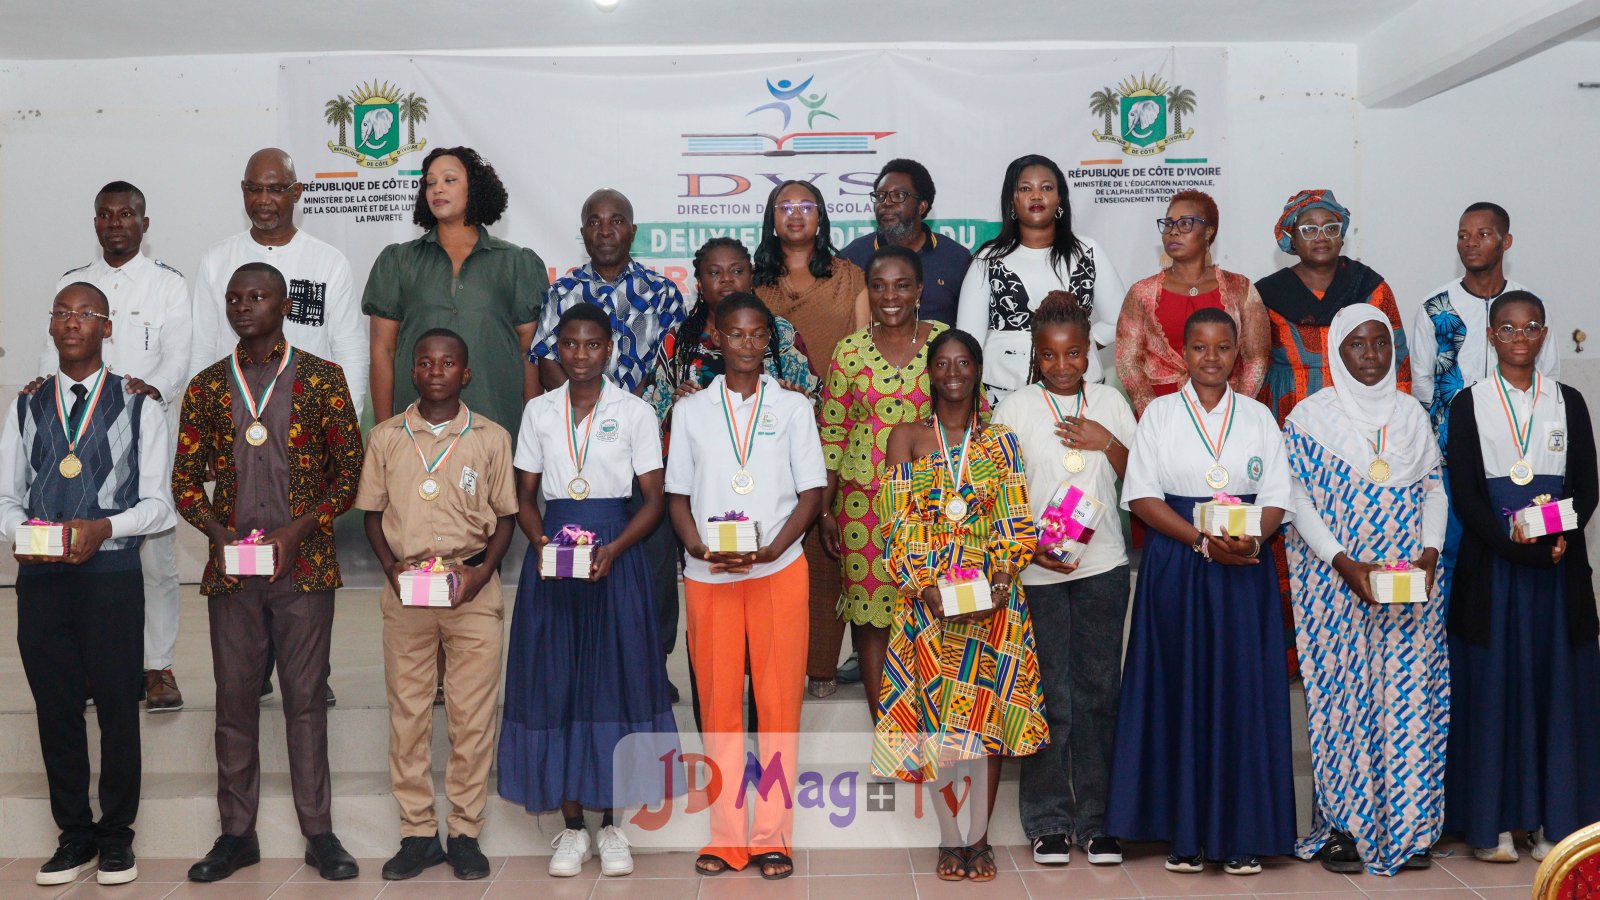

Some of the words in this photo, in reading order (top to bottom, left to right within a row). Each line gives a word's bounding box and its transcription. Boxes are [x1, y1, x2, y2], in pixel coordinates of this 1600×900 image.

[1068, 168, 1130, 178] RÉPUBLIQUE
[1132, 168, 1146, 177] DE
[1148, 165, 1174, 176] CÔTE
[1177, 167, 1221, 176] D'IVOIRE
[303, 181, 365, 192] RÉPUBLIQUE
[367, 181, 380, 190] DE
[382, 178, 409, 189] CÔTE
[1074, 180, 1111, 188] MINISTÈRE
[1124, 179, 1171, 187] L'ÉDUCATION
[1172, 179, 1215, 187] NATIONALE,
[1106, 187, 1175, 195] L'ALPHABÉTISATION
[304, 195, 343, 204] MINISTÈRE
[345, 195, 355, 203] DE
[356, 195, 366, 203] LA
[368, 193, 407, 202] COHÉSION
[303, 206, 313, 214] DE
[314, 206, 324, 214] LA
[325, 204, 368, 214] SOLIDARITÉ
[369, 204, 378, 212] ET
[379, 204, 389, 212] DE
[401, 203, 416, 211] LUT
[677, 204, 751, 215] DIRECTION
[826, 203, 875, 213] SCOLA
[355, 215, 365, 223] LA
[366, 213, 403, 222] PAUVRETÉ
[939, 225, 976, 250] DU
